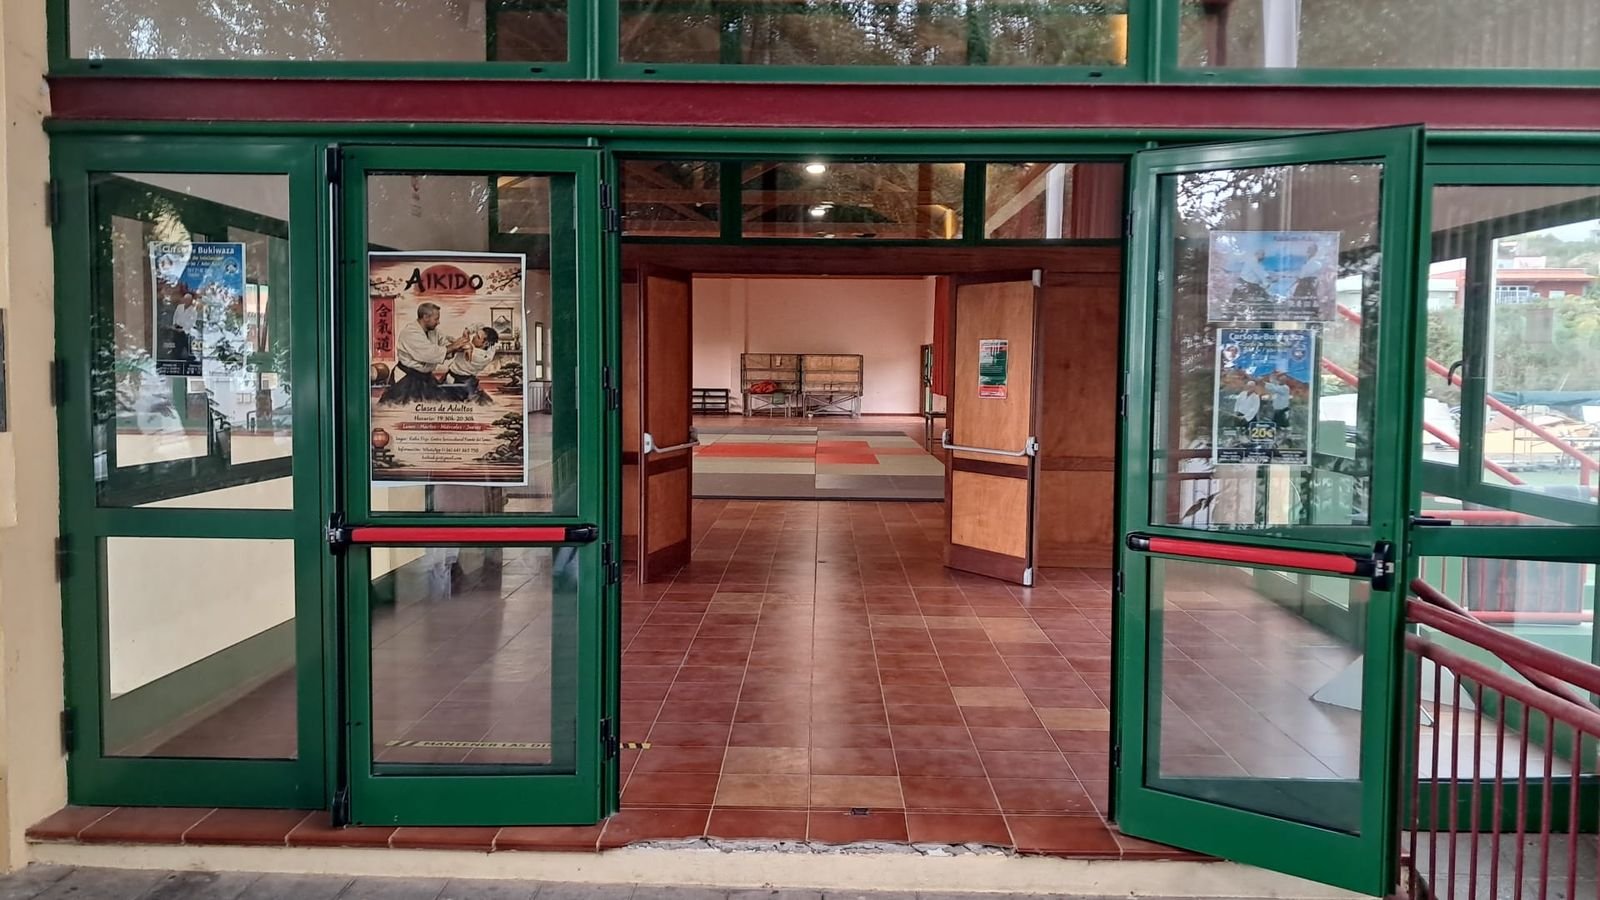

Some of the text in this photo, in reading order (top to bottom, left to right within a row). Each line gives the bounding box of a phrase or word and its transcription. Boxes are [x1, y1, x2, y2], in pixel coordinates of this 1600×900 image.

[197, 246, 235, 255] Bukiwaza
[404, 267, 484, 293] AIKIDO
[415, 404, 473, 412] Clases de Adultos
[1251, 427, 1274, 438] 20€
